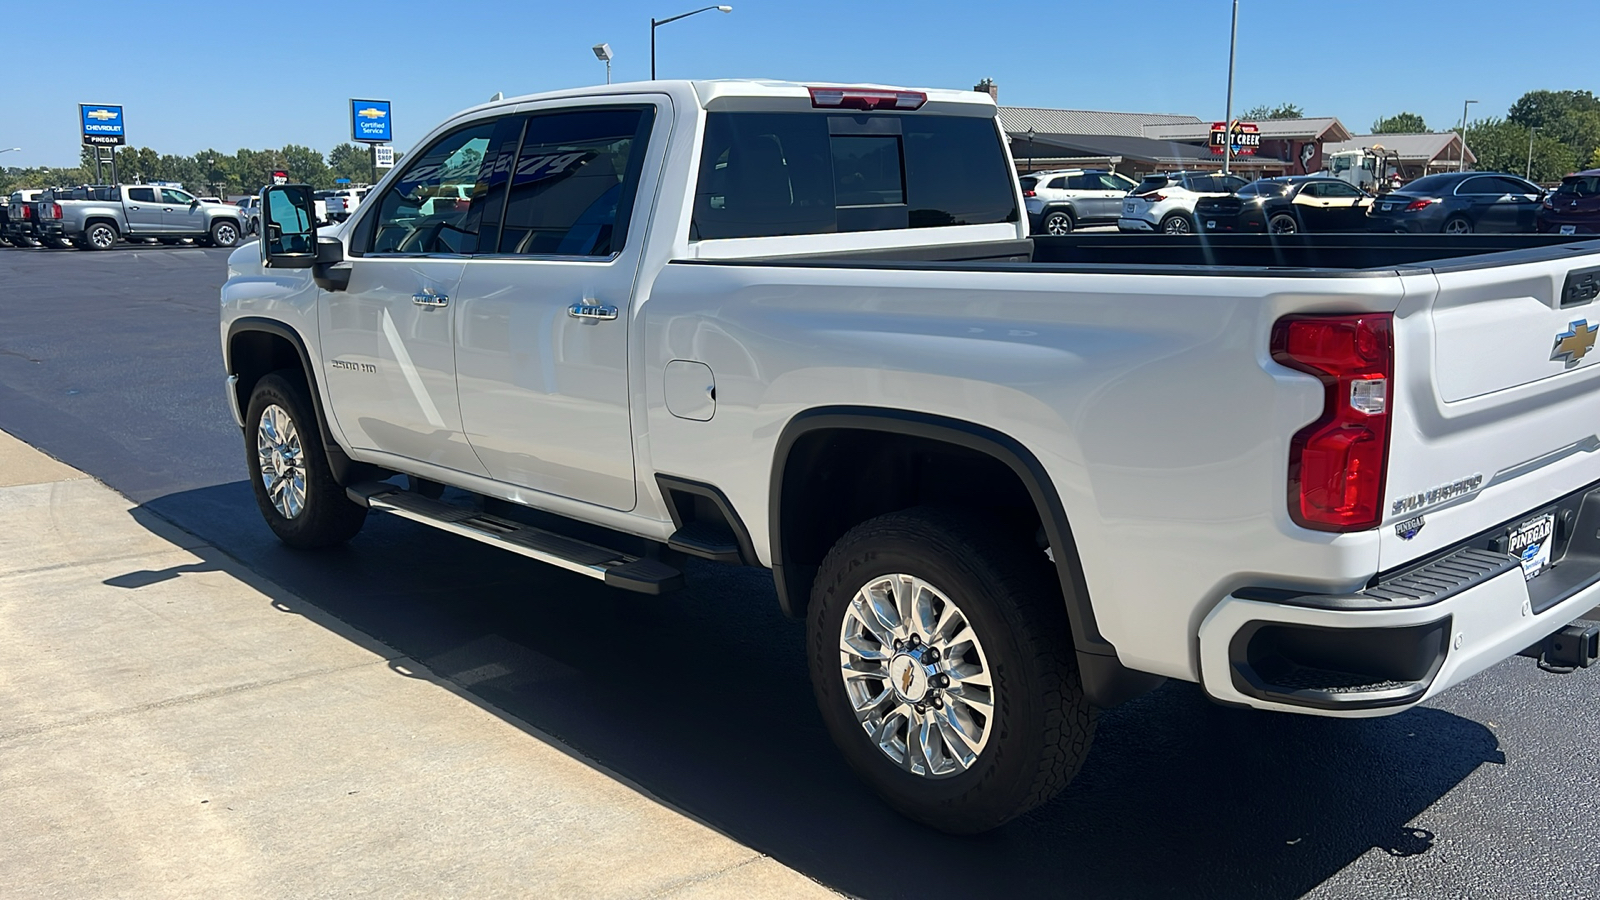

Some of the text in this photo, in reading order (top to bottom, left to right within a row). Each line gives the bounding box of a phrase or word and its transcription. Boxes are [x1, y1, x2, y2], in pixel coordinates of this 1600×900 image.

[1216, 133, 1260, 145] FLT CREEK
[1392, 471, 1482, 516] SILVERADO
[1395, 514, 1425, 535] PINEGAR
[1510, 521, 1551, 552] PINEGAR
